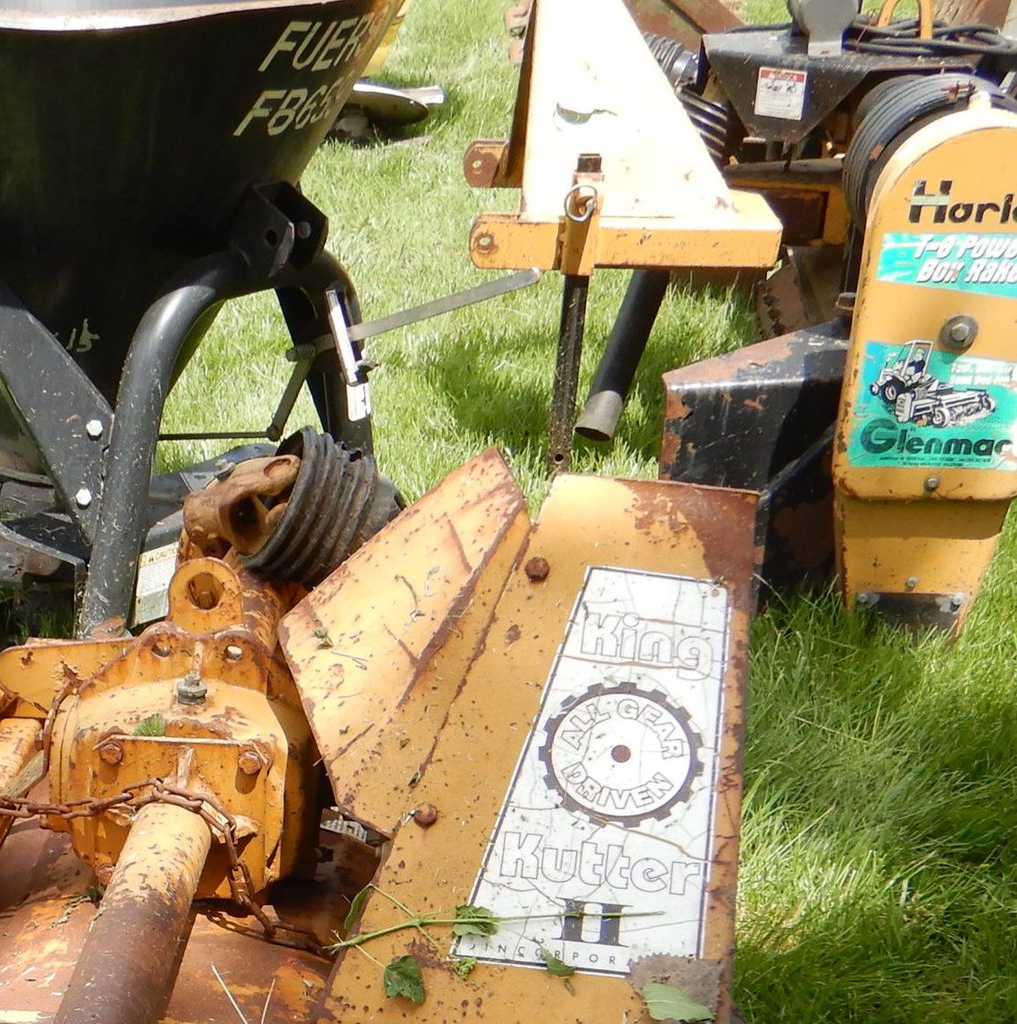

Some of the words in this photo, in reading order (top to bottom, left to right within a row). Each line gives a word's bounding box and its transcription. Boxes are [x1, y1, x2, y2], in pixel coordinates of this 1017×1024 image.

[908, 180, 1017, 224] Harl
[581, 611, 713, 681] King
[561, 703, 611, 750] ALL
[617, 698, 684, 760] GEAR
[561, 761, 674, 809] DRIVEN
[499, 831, 701, 896] Kutter
